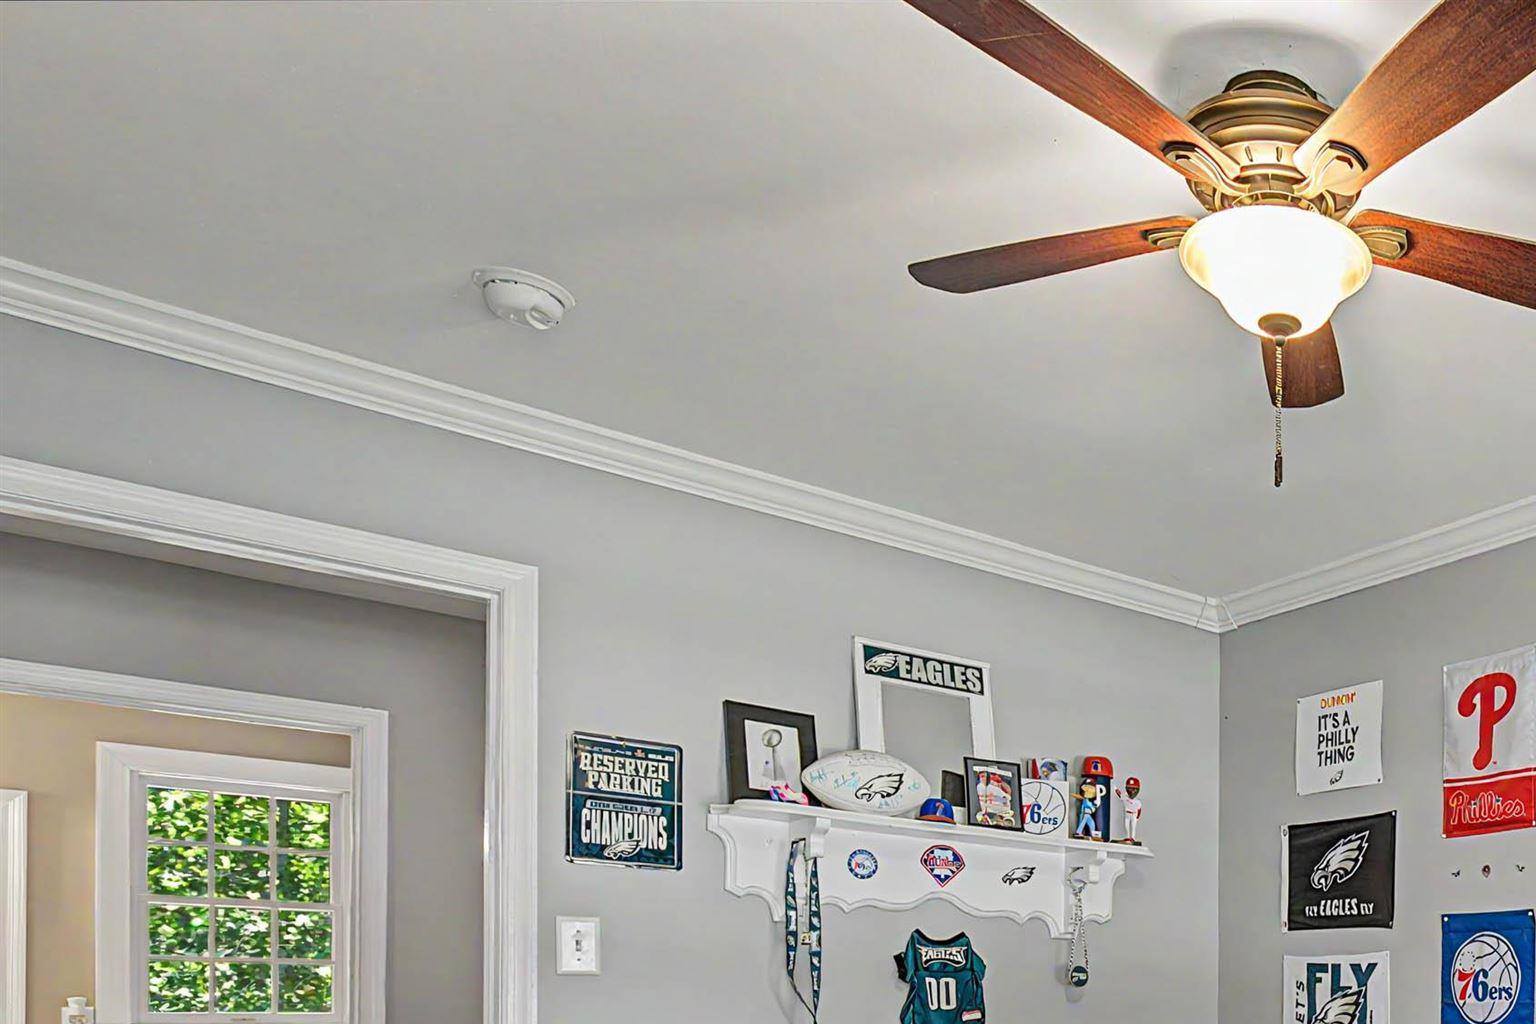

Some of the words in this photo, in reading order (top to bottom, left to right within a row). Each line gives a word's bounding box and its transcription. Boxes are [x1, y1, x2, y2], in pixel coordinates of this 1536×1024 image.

[898, 654, 982, 692] EAGLES
[1318, 713, 1339, 732] IT'S
[1342, 710, 1350, 726] A
[1457, 672, 1517, 771] P
[1317, 726, 1359, 749] PHILLY
[579, 751, 669, 782] RESERVED
[1317, 745, 1354, 767] THING
[586, 770, 663, 797] PARKING
[1450, 790, 1526, 825] Phillies
[580, 807, 668, 851] CHAMPIONS
[1320, 898, 1358, 916] EAGLES
[1457, 968, 1513, 1002] 76ers
